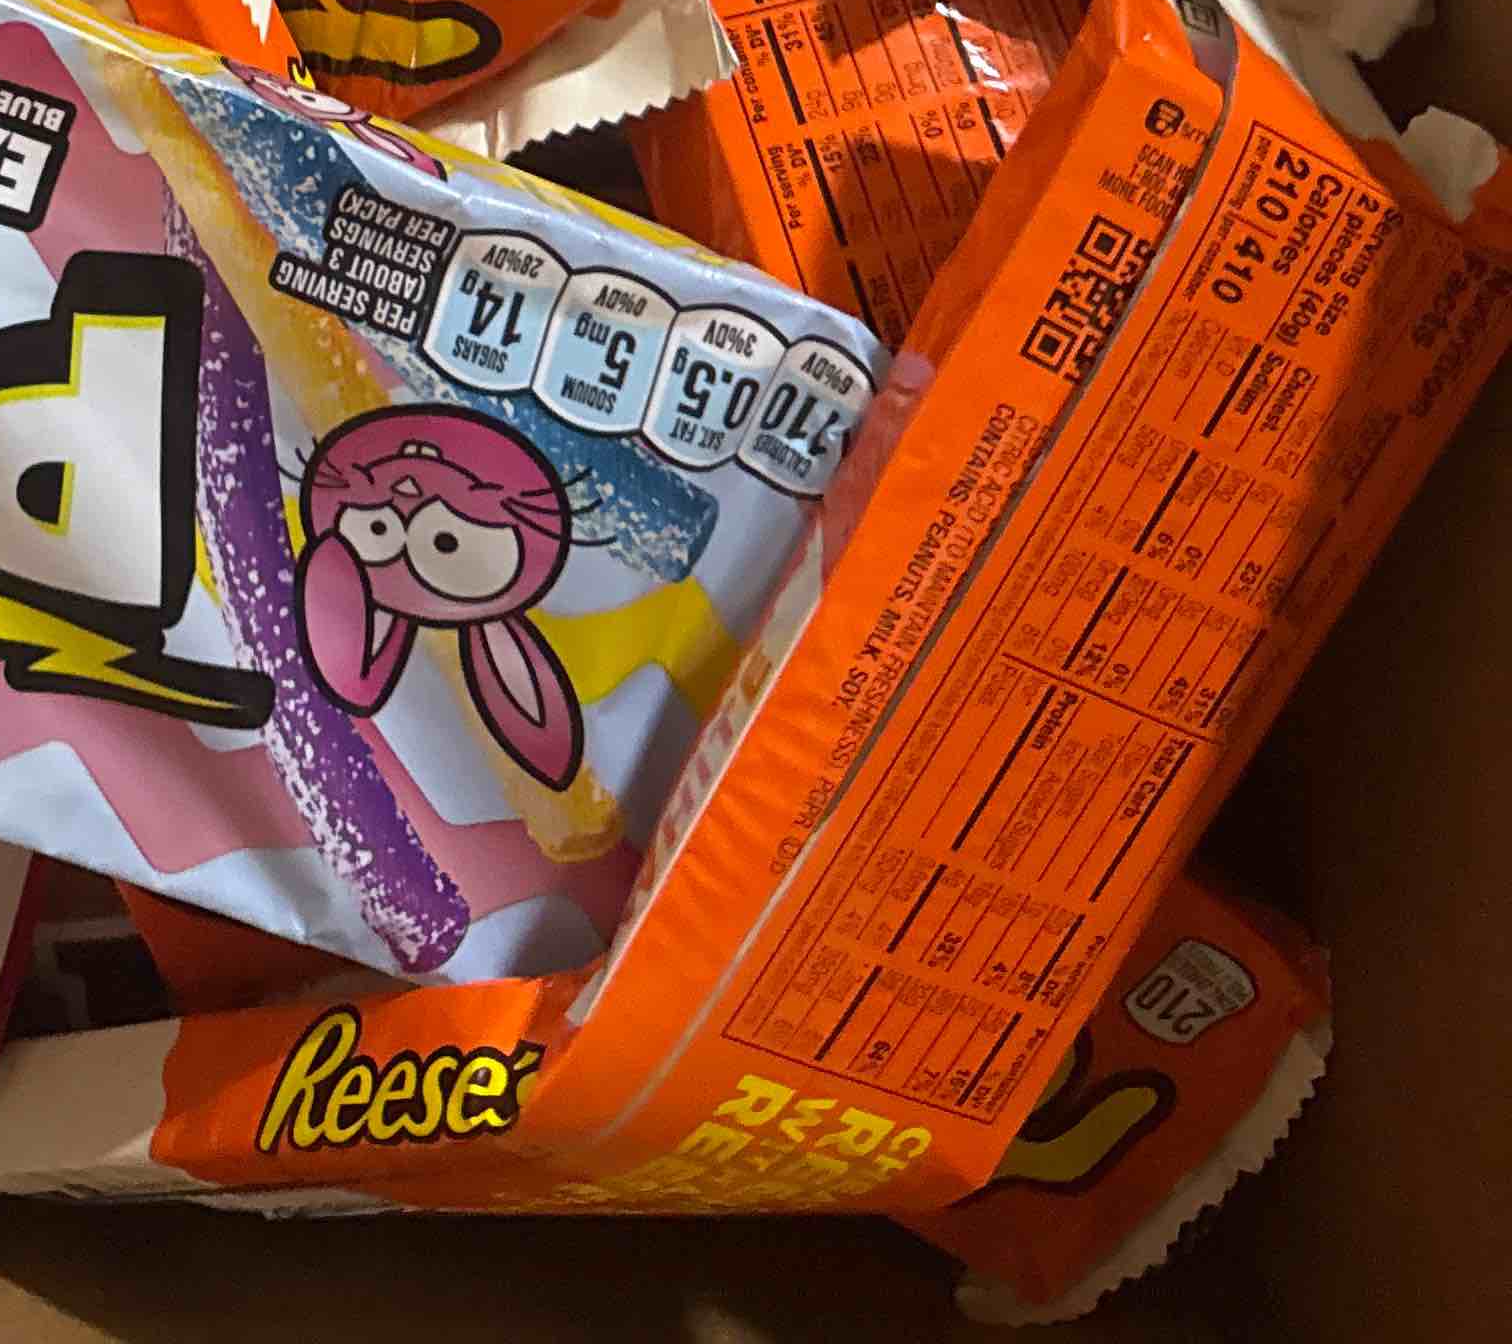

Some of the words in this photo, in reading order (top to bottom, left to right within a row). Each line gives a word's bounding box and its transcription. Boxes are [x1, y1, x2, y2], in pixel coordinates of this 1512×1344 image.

[774, 10, 805, 53] 31%
[745, 98, 768, 126] Per
[915, 105, 945, 141] 0%
[949, 100, 976, 133] 6%
[762, 143, 796, 203] serving
[815, 131, 847, 175] 15%
[334, 184, 405, 232] PACK)
[1245, 144, 1319, 228] 210
[1354, 190, 1381, 215] 2
[326, 213, 438, 274] SERVINGS
[401, 212, 449, 248] PER
[782, 203, 804, 232] Per
[1267, 168, 1348, 280] Calories
[326, 244, 346, 270] 3
[478, 234, 546, 287] 28%DV
[1204, 229, 1273, 311] 410
[1307, 209, 1369, 292] pieces
[1336, 201, 1409, 298] Serving
[271, 258, 373, 318] SERVING
[342, 250, 429, 304] (ABOUT
[592, 278, 650, 323] 0%DV
[369, 295, 420, 336] PER
[698, 314, 760, 364] 3%DV
[1270, 282, 1328, 353] (40g)
[1312, 288, 1356, 342] size
[447, 330, 511, 378] SUGARS
[557, 371, 620, 418] SODIUM
[653, 343, 763, 438] 0.5g
[1231, 346, 1288, 422] Sodium
[1254, 360, 1316, 442] Cholest.
[667, 414, 698, 445] FAT
[940, 399, 1019, 512] CONTAINS:
[986, 412, 1042, 483] CITRIC
[961, 474, 1007, 530] ACID
[885, 506, 957, 609] PEANUTS,
[1143, 527, 1175, 566] 6%
[1170, 540, 1207, 581] 0%
[889, 557, 960, 656] MAINTAIN
[851, 603, 901, 668] MILK,
[827, 662, 869, 715] SOY.
[1026, 685, 1078, 757] Protein
[1143, 729, 1185, 781] Total
[1116, 772, 1160, 827] Carb.
[256, 1006, 535, 1152] Reese'
